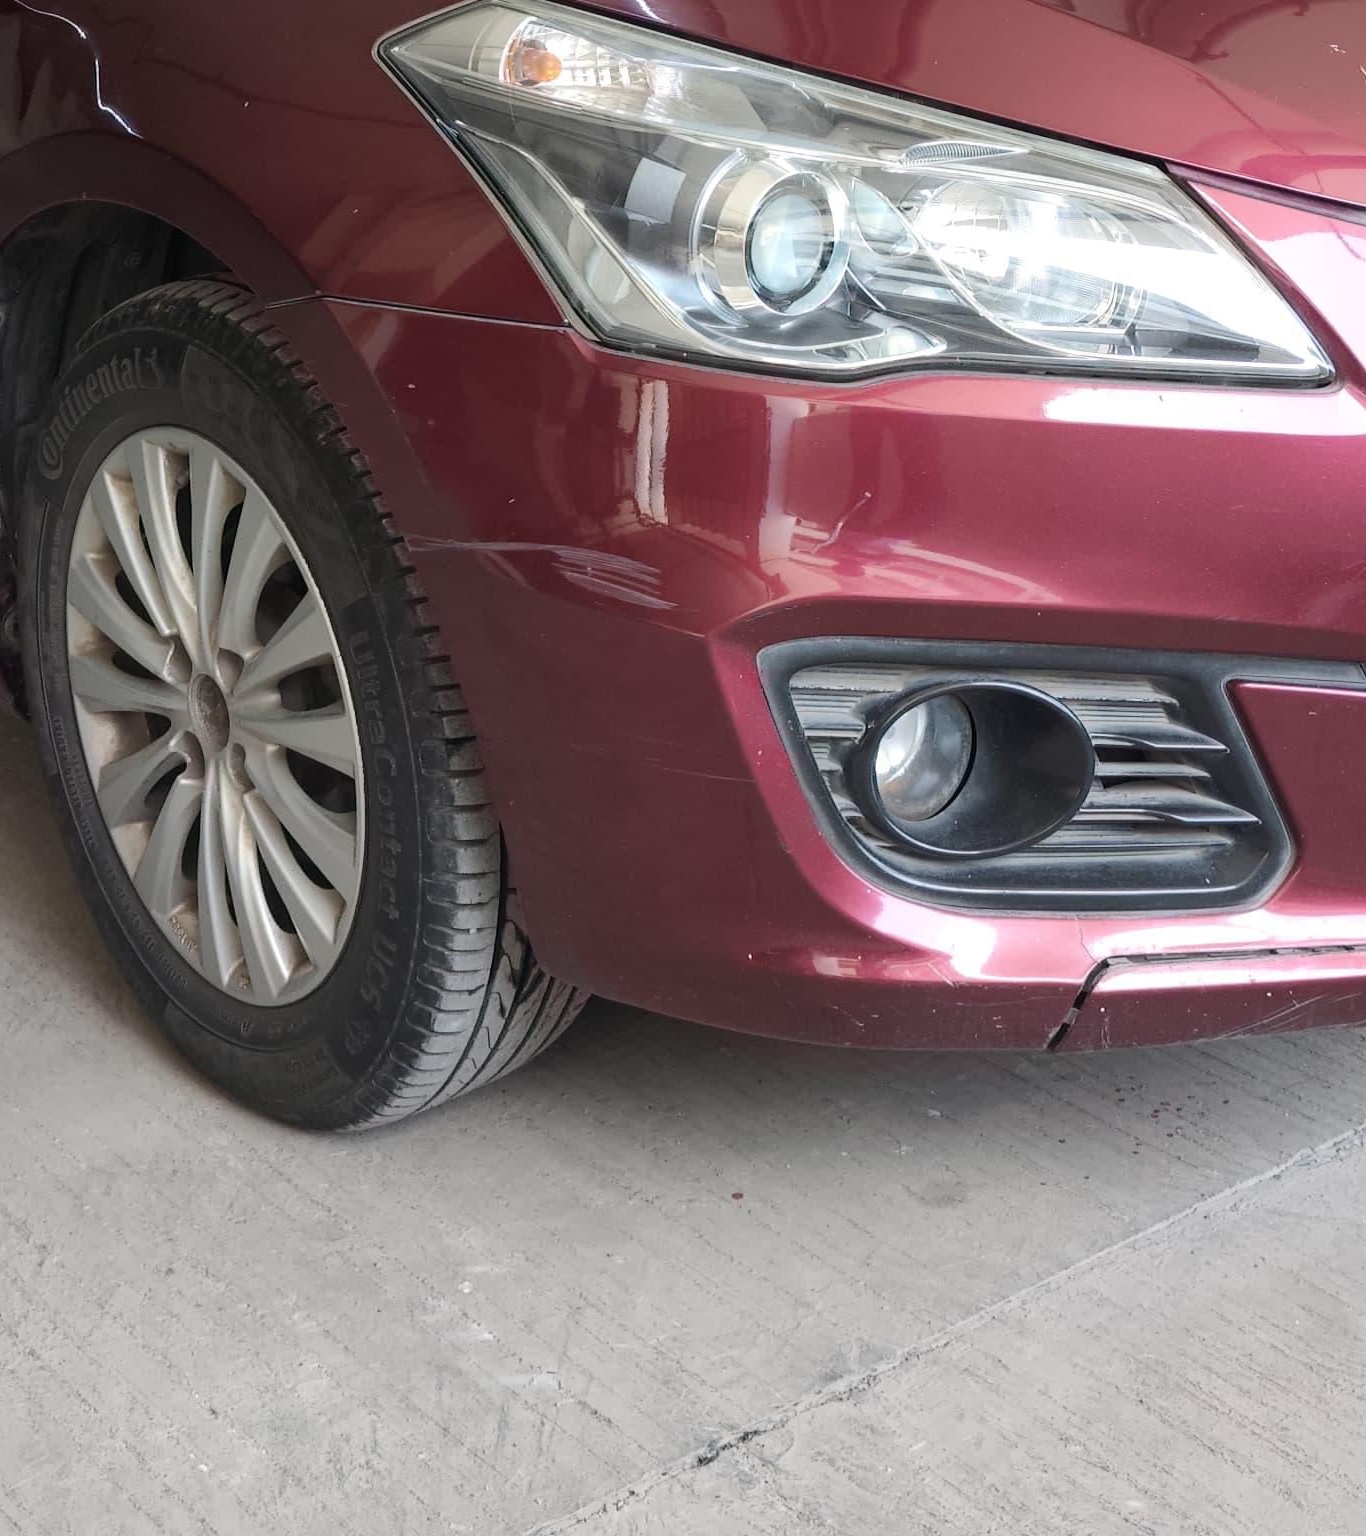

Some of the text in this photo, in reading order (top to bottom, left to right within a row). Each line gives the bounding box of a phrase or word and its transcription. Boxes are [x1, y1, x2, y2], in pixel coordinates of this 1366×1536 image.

[37, 346, 141, 480] Continental
[349, 631, 402, 1008] UltraContact UC6
